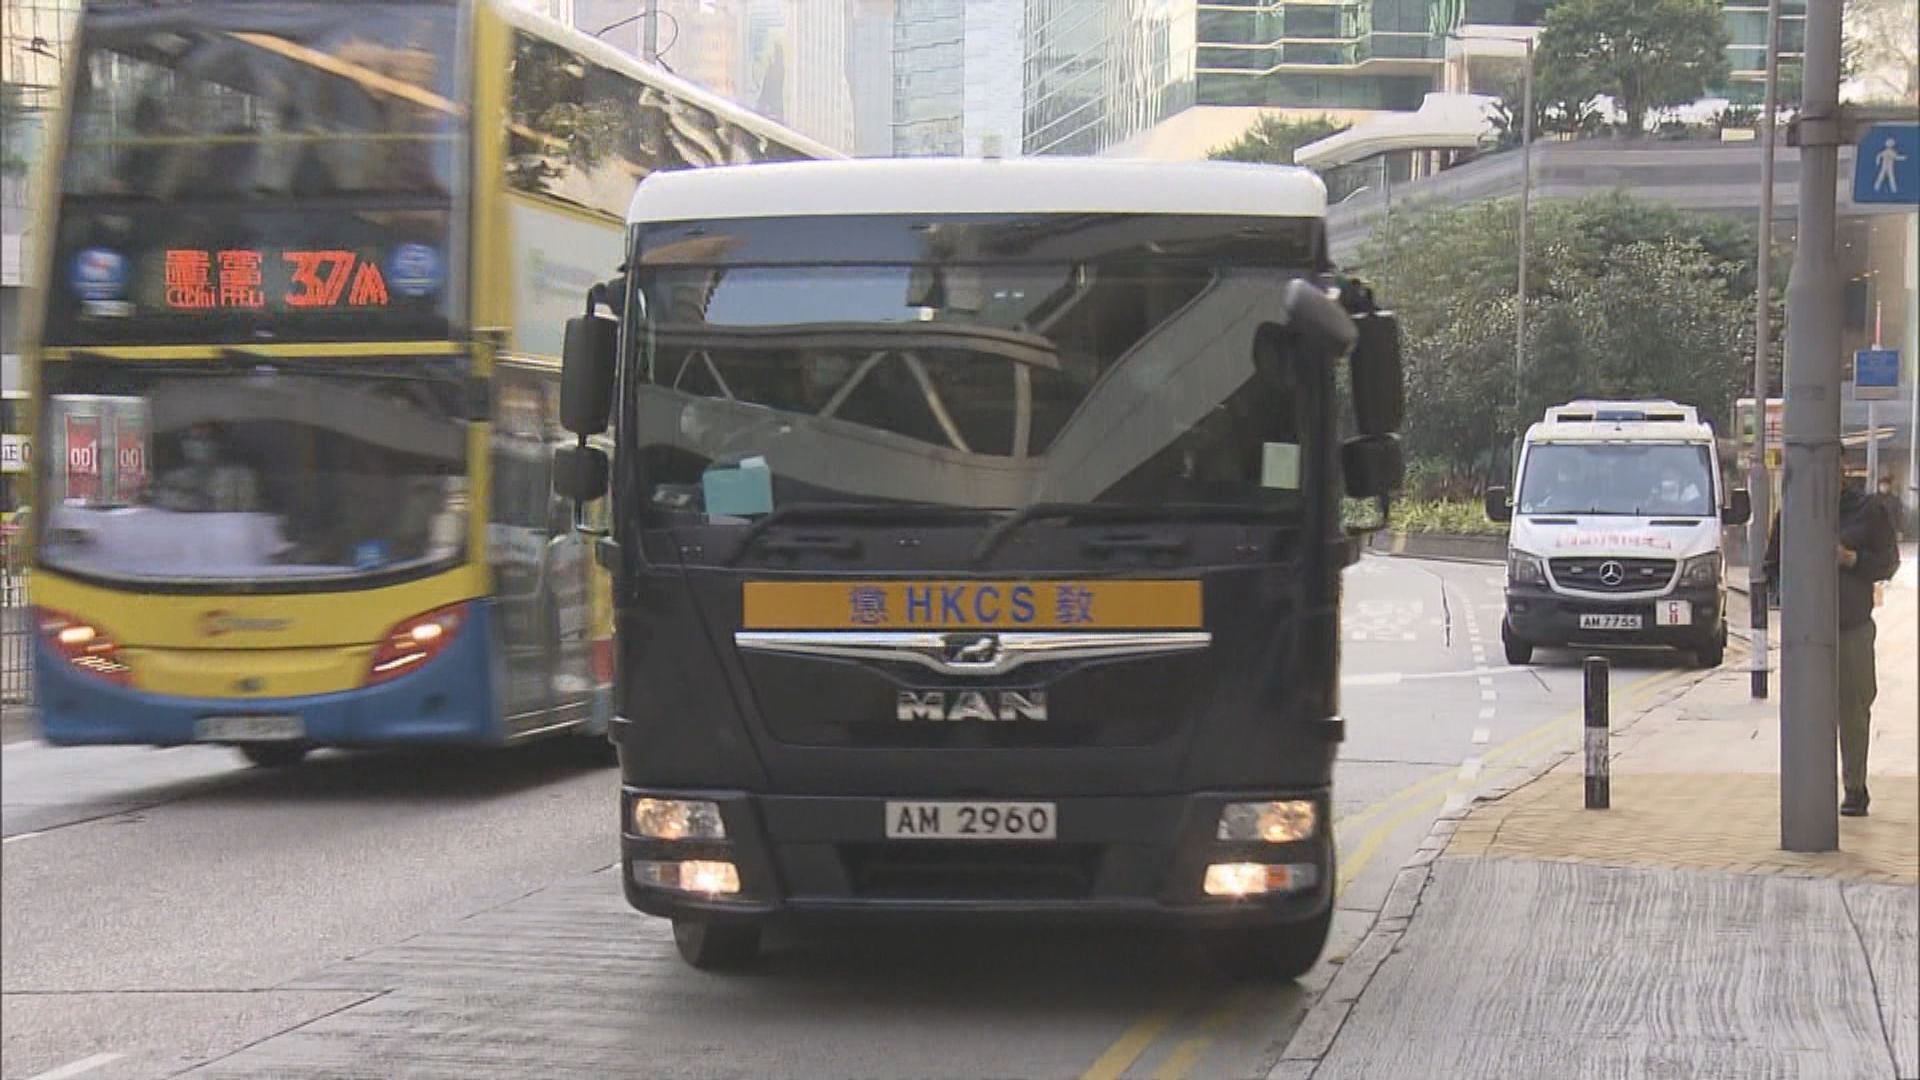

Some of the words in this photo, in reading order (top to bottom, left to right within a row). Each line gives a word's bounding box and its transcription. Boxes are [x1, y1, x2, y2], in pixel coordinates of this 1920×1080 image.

[907, 585, 1036, 623] HKCS
[1584, 616, 1601, 627] AM
[897, 691, 1048, 721] MAN
[896, 805, 940, 833] AM
[957, 806, 1049, 833] 2960
